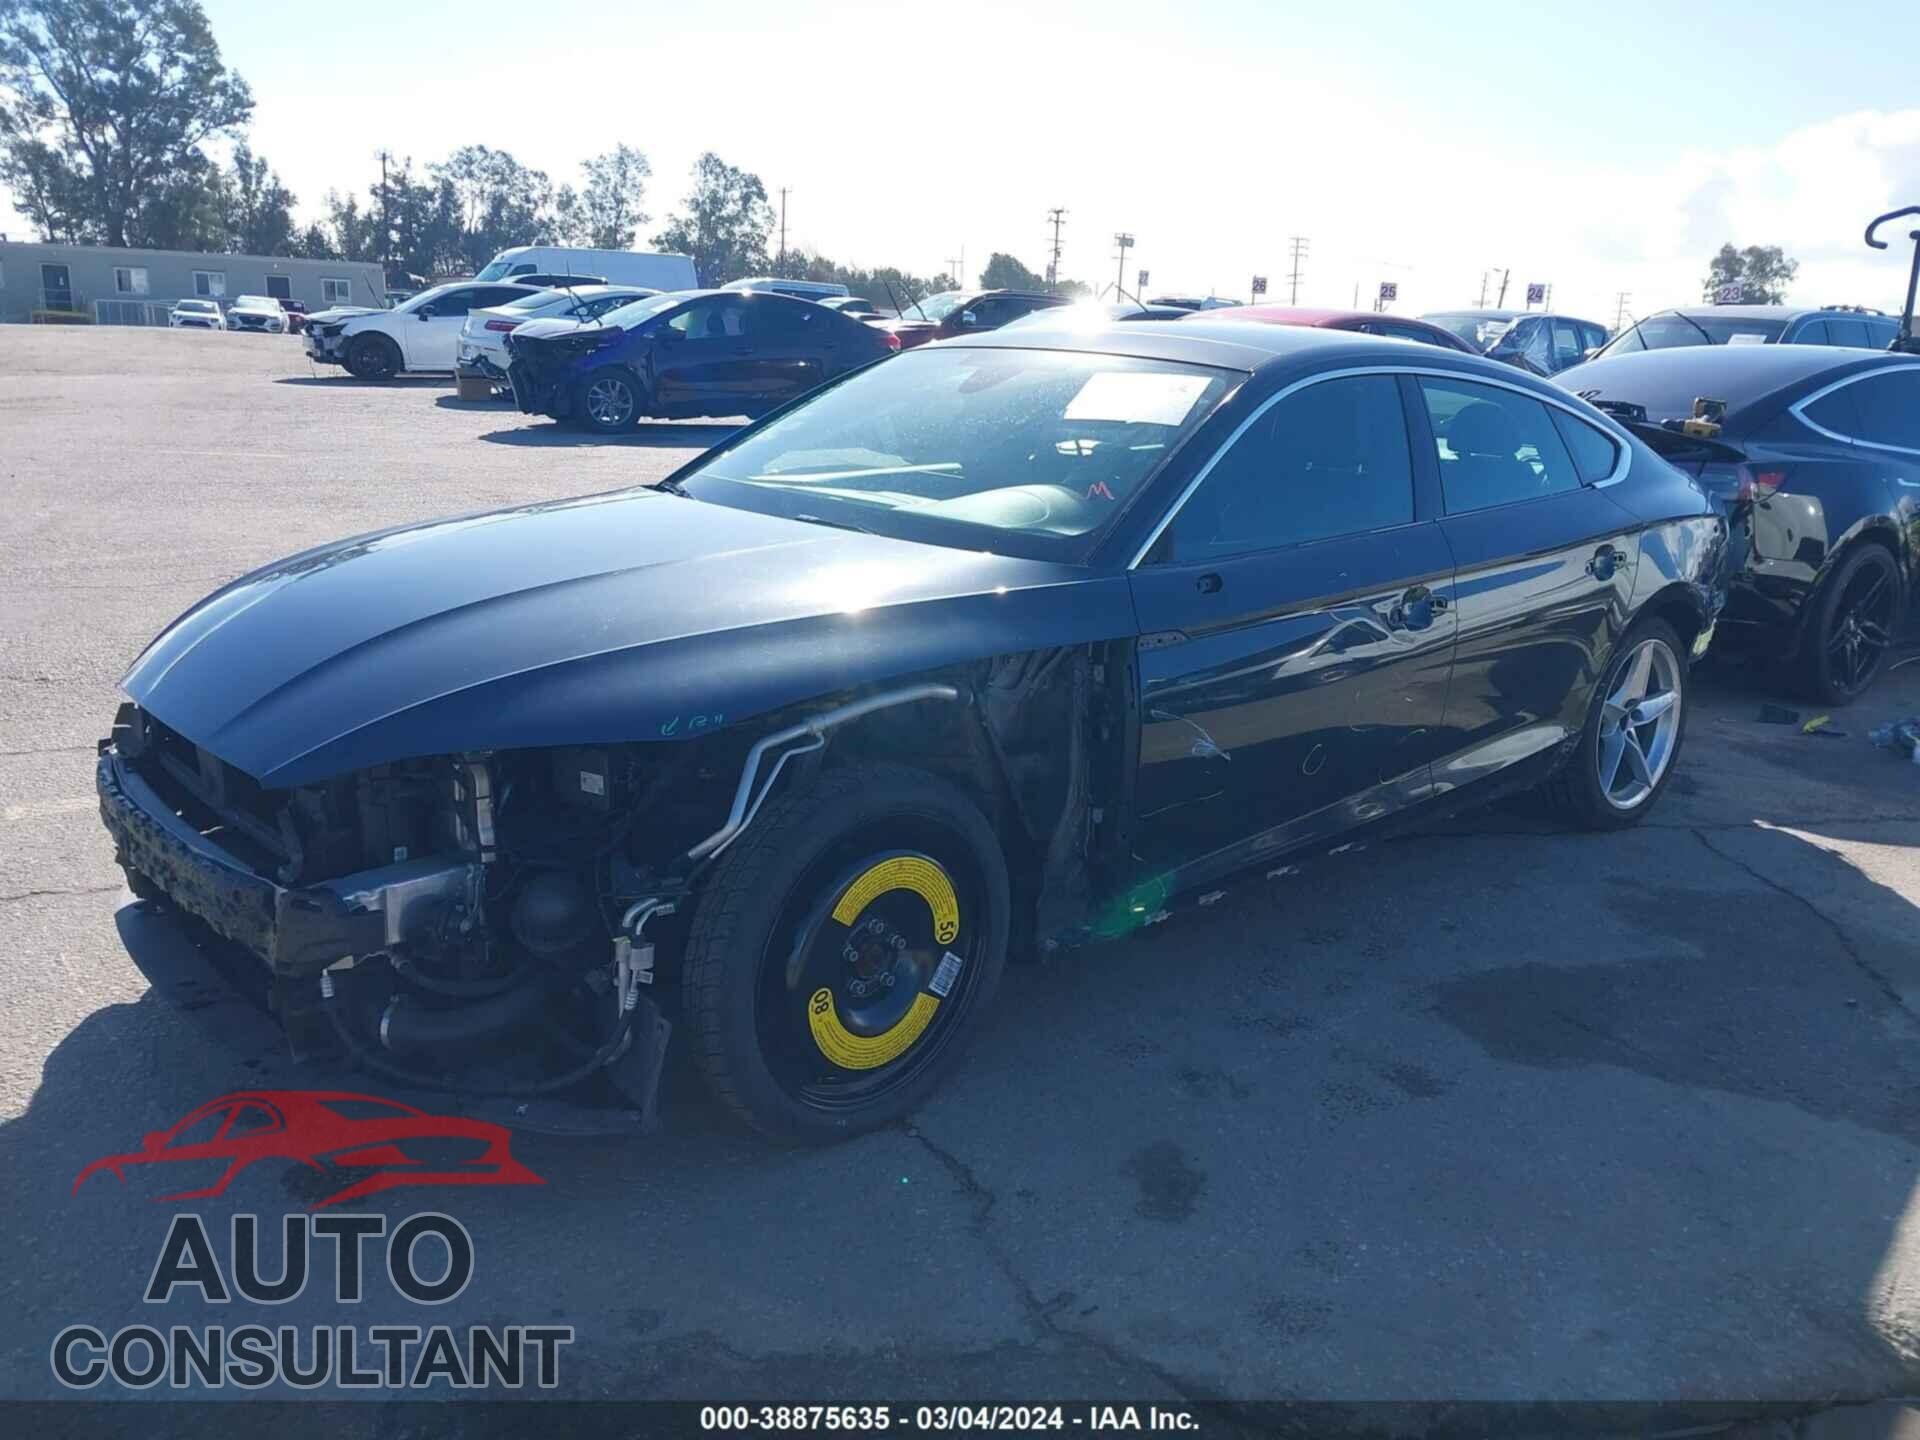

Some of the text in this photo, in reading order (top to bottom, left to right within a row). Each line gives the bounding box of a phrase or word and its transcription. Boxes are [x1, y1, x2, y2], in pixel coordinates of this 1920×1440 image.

[1252, 279, 1267, 292] 26
[1380, 285, 1397, 298] 25
[1528, 286, 1543, 300] 24
[1721, 286, 1740, 301] 23
[940, 920, 954, 942] 50
[814, 990, 829, 1015] 80
